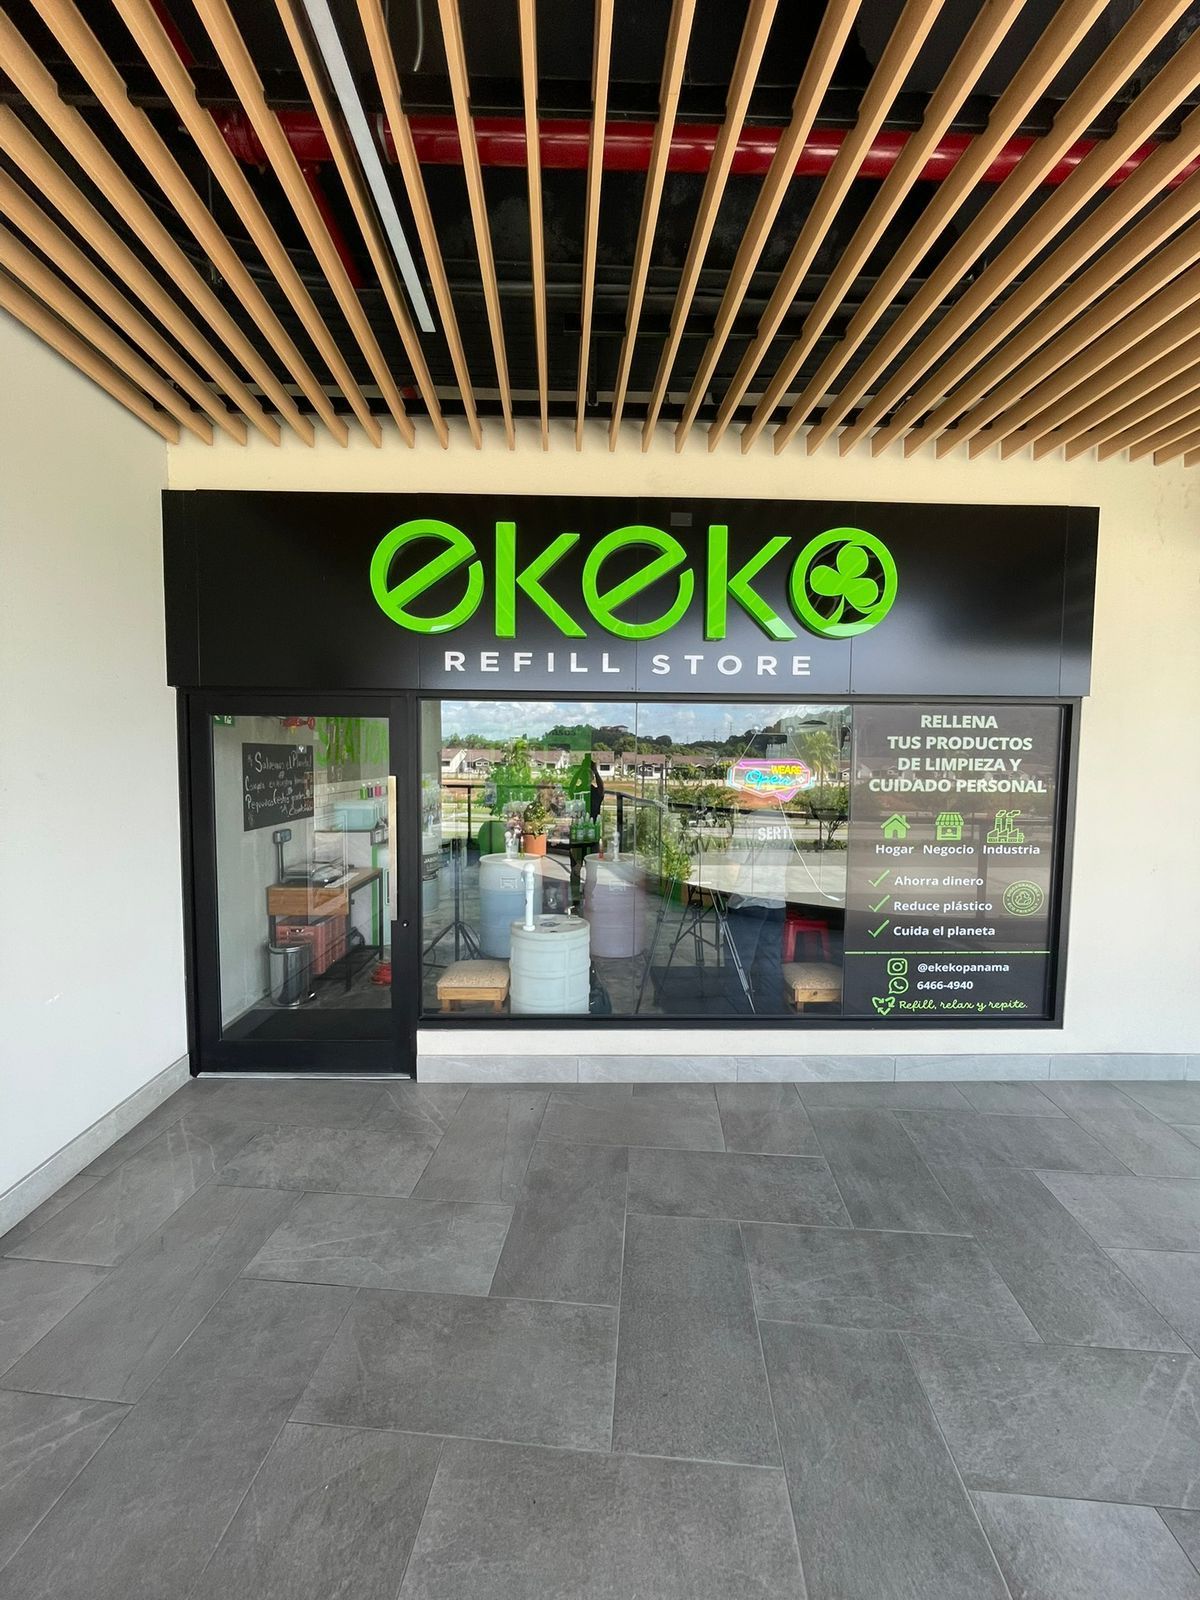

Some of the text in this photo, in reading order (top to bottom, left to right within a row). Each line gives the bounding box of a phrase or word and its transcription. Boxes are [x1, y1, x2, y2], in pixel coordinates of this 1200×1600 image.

[369, 518, 898, 640] ekeko
[444, 651, 811, 676] REFILL STORE
[920, 714, 999, 729] RELLENA
[887, 735, 1033, 751] TUS PRODUCTOS
[897, 757, 1022, 772] DE LIMPIEZA Y
[745, 769, 793, 789] Open
[868, 778, 1047, 793] CUIDADO PERSONAL
[875, 844, 1040, 857] Hogar Negocio Industria
[894, 875, 984, 886] Ahorra dinero
[894, 900, 993, 914] Reduce plástico
[893, 925, 996, 938] Cuida el planeta
[917, 963, 1010, 975] @ekekopanama
[916, 981, 974, 990] 6466-4940
[939, 999, 975, 1010] relax
[976, 1002, 987, 1012] y
